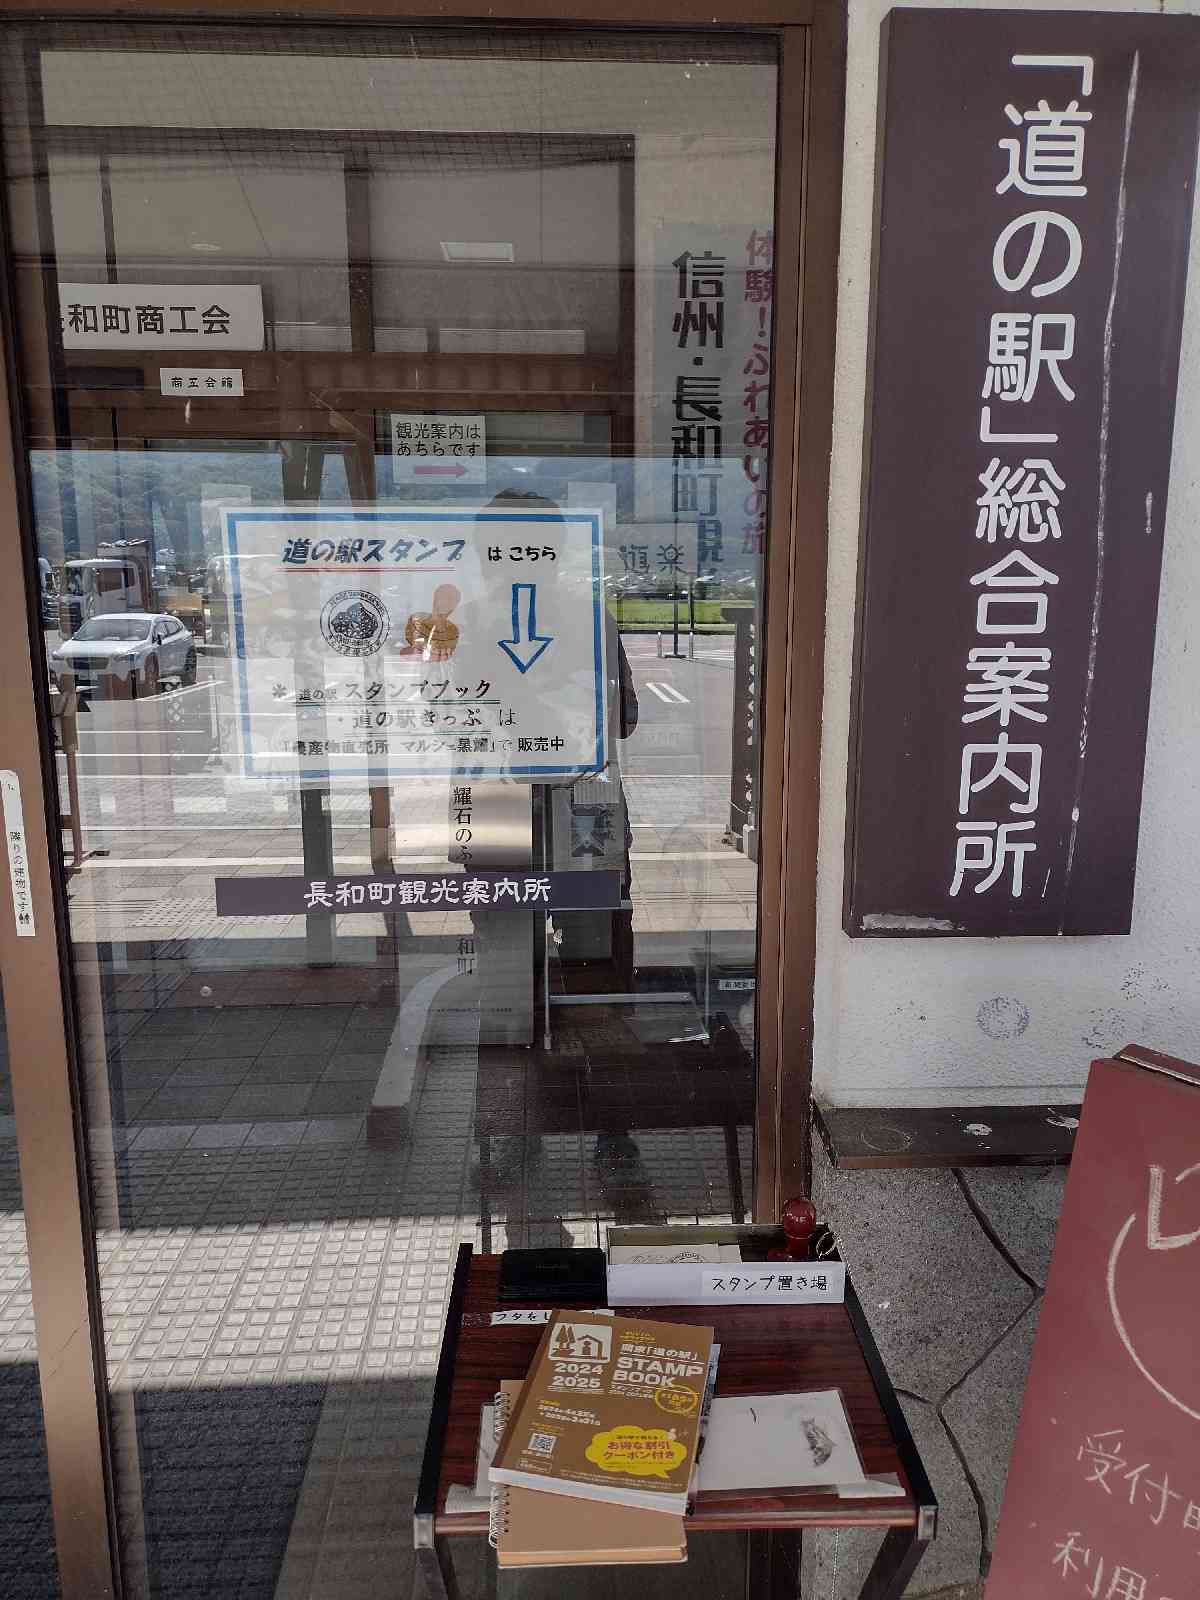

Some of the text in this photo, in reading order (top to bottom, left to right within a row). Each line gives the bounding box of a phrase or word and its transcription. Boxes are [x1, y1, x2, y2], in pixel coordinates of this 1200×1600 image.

[61, 303, 231, 335] 和町商工会
[396, 421, 481, 440] 観光案内は
[397, 440, 481, 458] あちらです
[949, 53, 1094, 899] 「道の駅」総合案内所
[281, 537, 556, 565] 道の駅スタンプ はこちら
[518, 735, 565, 752] 販売中
[302, 876, 552, 909] 長和町観光案内所
[711, 1274, 828, 1292] スタンプ置き場
[554, 1362, 604, 1375] 2024
[617, 1356, 704, 1377] STAMP
[551, 1375, 602, 1389] 2025
[612, 1369, 677, 1387] BOOK
